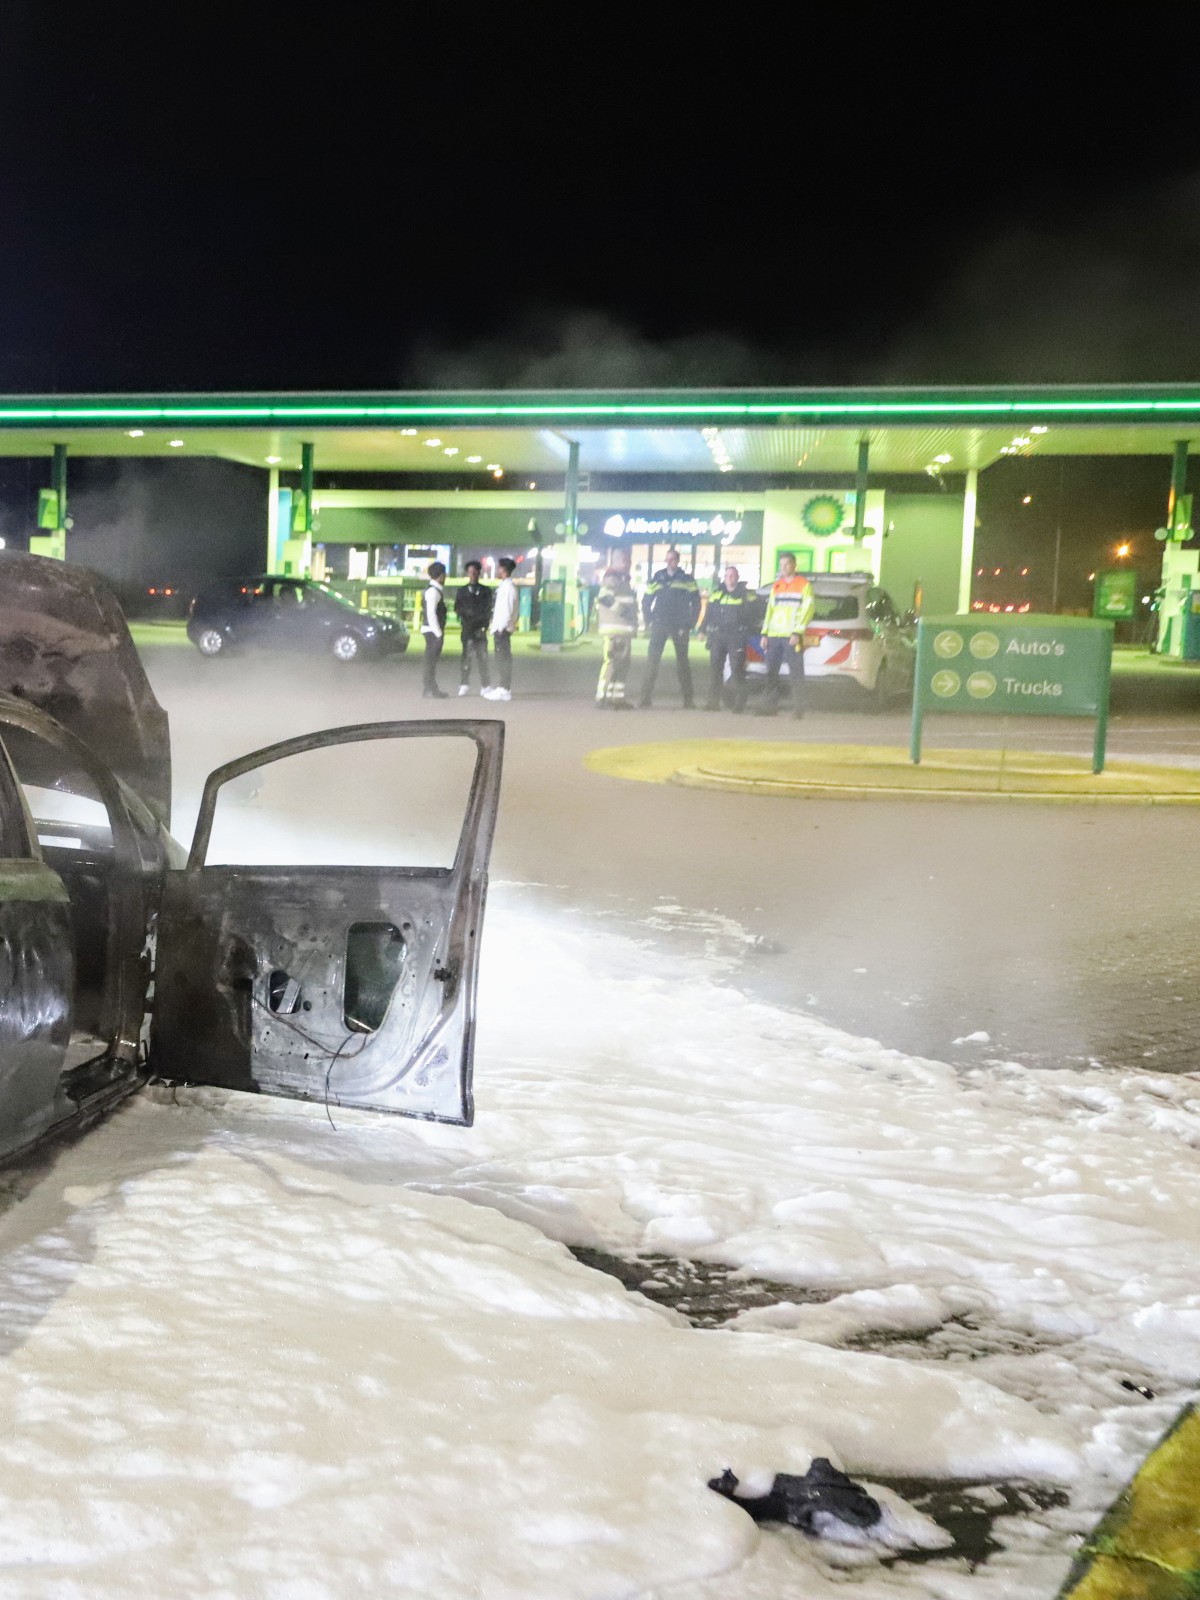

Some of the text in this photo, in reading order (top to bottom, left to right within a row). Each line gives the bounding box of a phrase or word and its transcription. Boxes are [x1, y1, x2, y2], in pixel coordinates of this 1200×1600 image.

[625, 517, 669, 534] Albert
[1005, 639, 1064, 656] Auto's
[1004, 678, 1062, 696] Trucks
